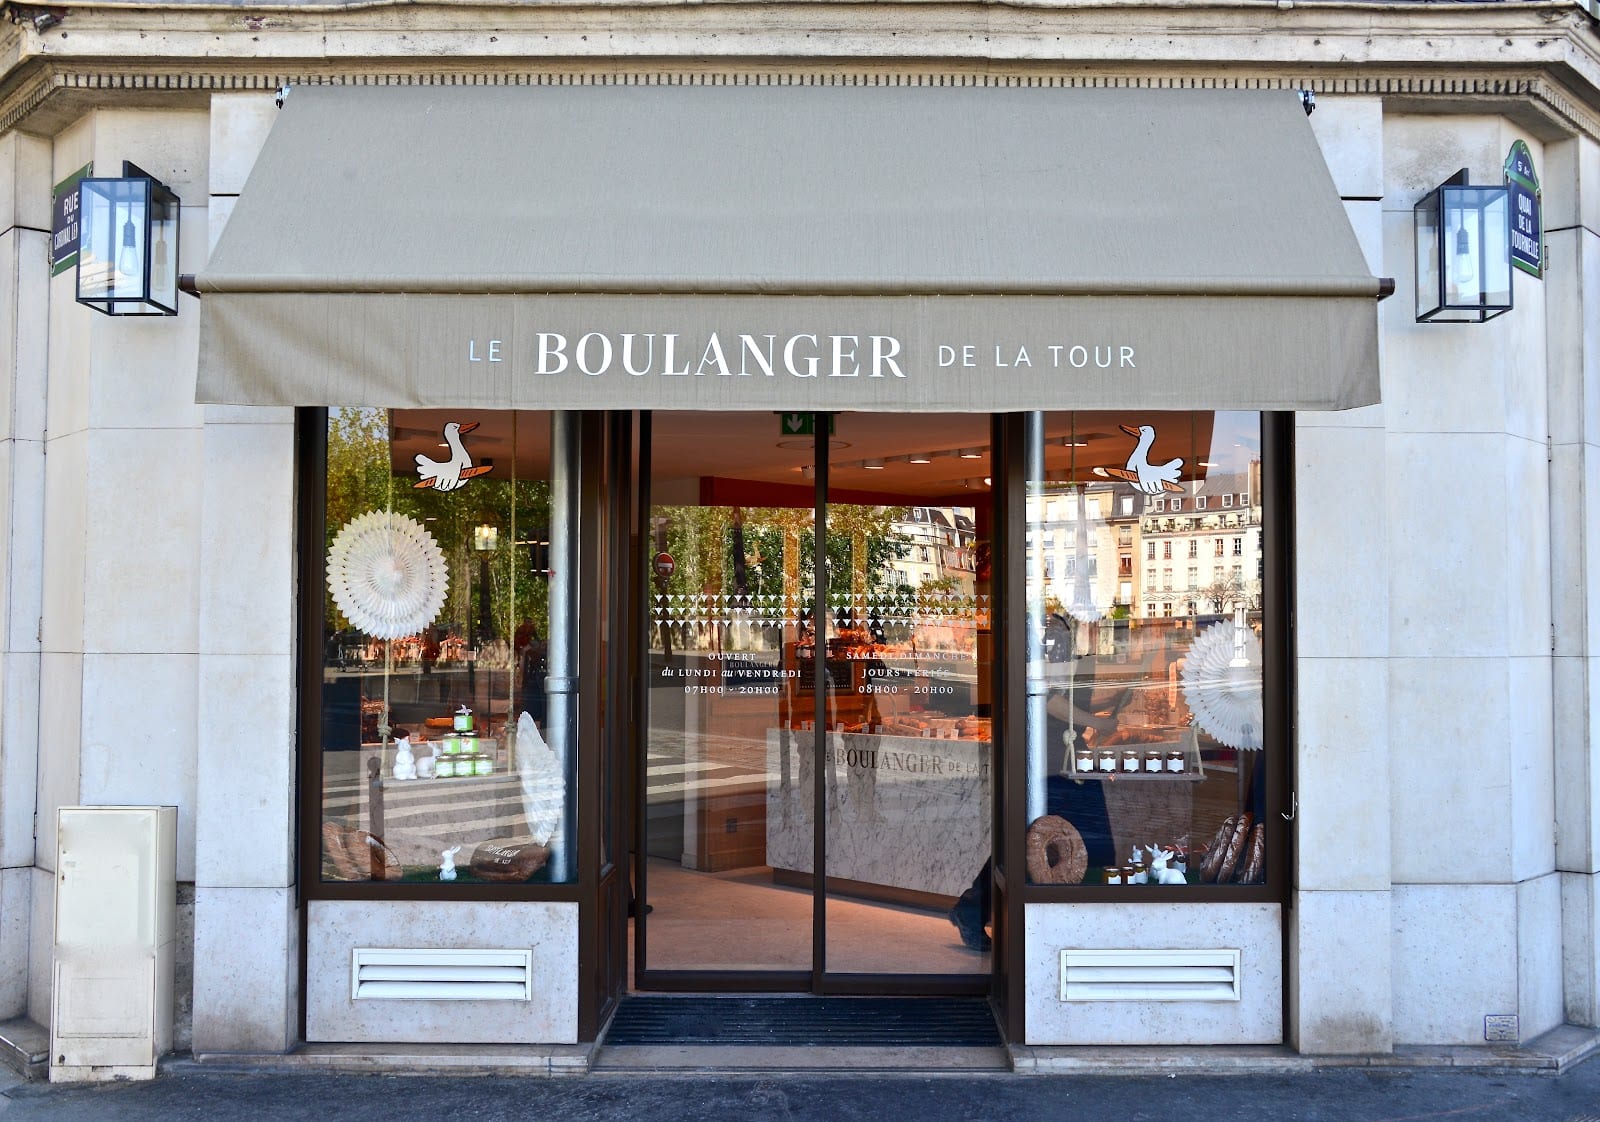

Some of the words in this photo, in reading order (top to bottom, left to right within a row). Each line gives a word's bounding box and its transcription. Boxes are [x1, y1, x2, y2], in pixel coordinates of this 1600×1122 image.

[64, 192, 79, 216] RUE
[1518, 193, 1532, 217] QUAI
[67, 213, 75, 224] DU
[1518, 214, 1526, 231] DE
[1525, 218, 1532, 235] LA
[1512, 229, 1539, 260] TOURNELLE
[469, 340, 502, 362] LE
[534, 331, 907, 379] BOULANGER
[938, 345, 976, 367] DE
[995, 345, 1032, 367] LA
[1048, 345, 1137, 368] TOUR
[708, 653, 756, 661] OUVERT
[661, 666, 674, 677] du
[678, 669, 717, 677] LUNDI
[721, 668, 734, 678] au
[738, 669, 802, 678] VENDREDI
[861, 669, 901, 678] JOURS
[684, 685, 723, 695] 07H00
[739, 686, 779, 694] 20H00
[858, 683, 898, 694] 08H00
[914, 686, 954, 694] 20H00
[836, 749, 943, 774] BOULANGER
[948, 761, 961, 772] DE
